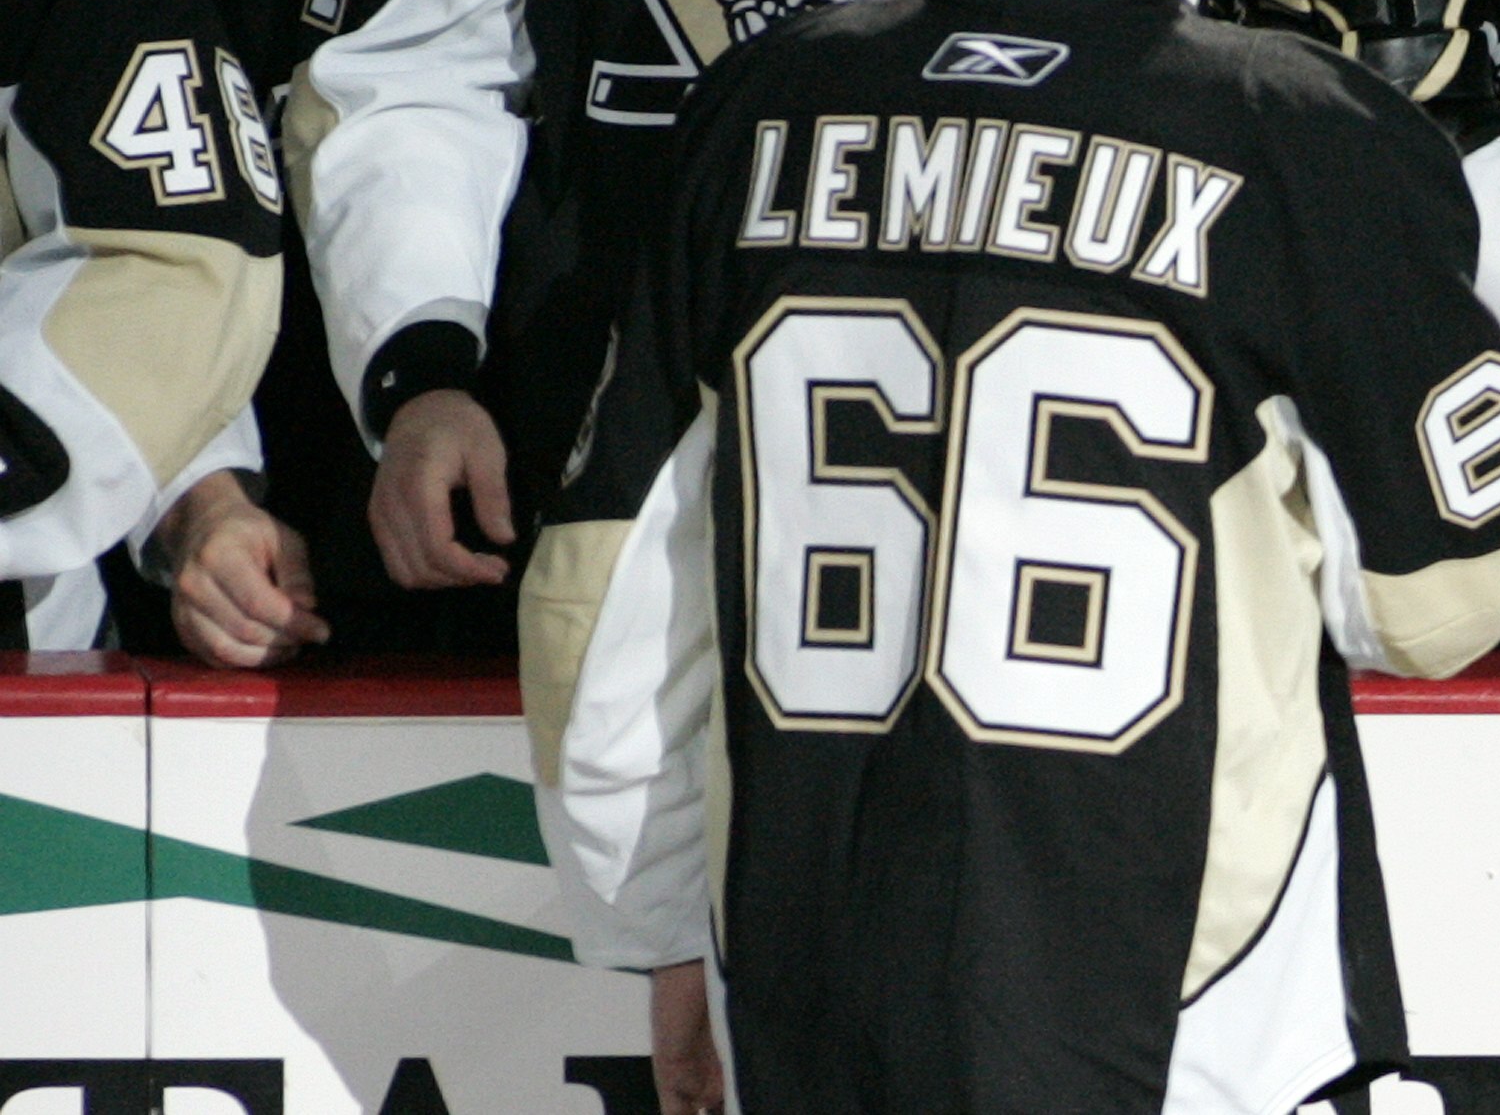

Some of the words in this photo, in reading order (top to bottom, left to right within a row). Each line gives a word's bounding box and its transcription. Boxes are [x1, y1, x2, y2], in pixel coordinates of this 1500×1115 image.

[90, 38, 284, 215] 48
[735, 113, 1243, 300] LEMIEUX
[730, 293, 1218, 757] 66
